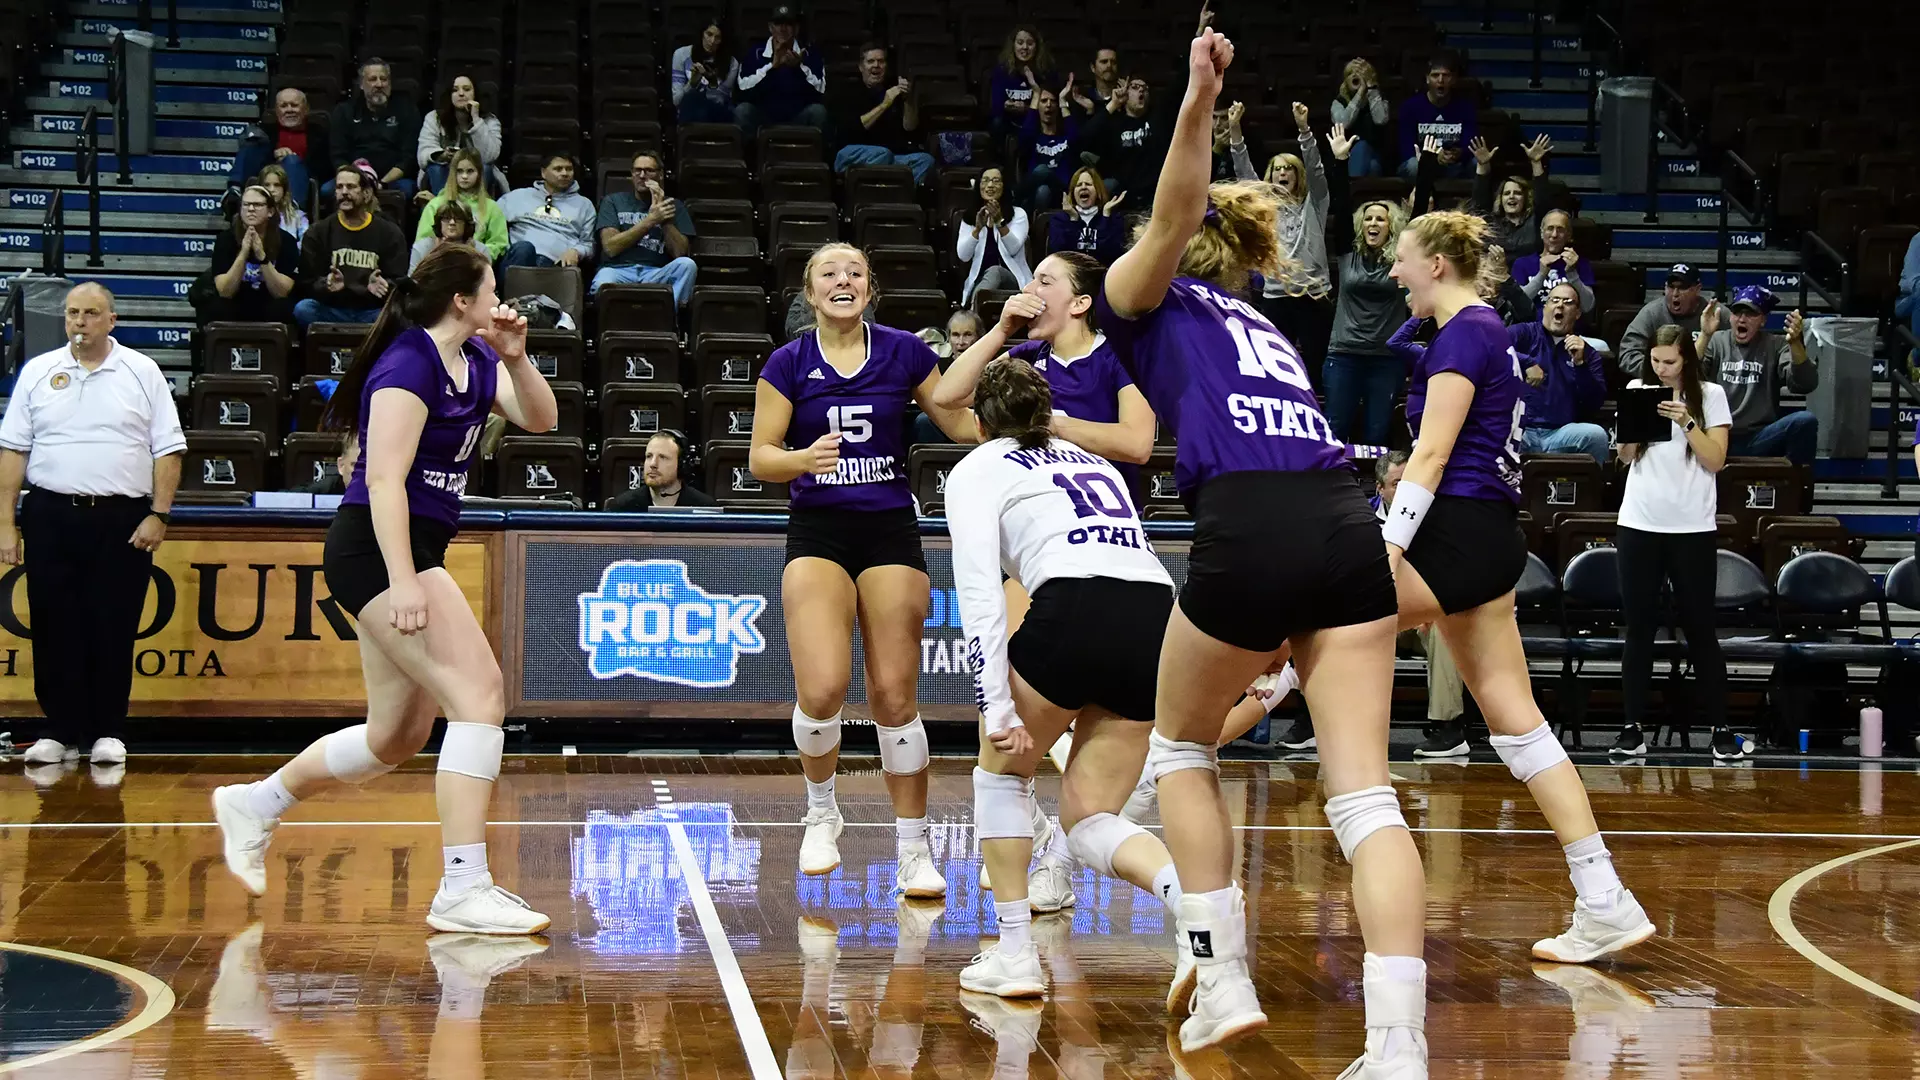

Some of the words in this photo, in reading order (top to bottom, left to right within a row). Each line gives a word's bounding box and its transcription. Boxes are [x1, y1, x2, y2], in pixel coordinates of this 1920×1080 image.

[240, 28, 258, 38] 103
[86, 53, 105, 63] 102
[236, 59, 253, 69] 103
[72, 85, 92, 96] 102
[227, 91, 246, 102] 103
[56, 120, 75, 131] 102
[215, 126, 235, 137] 103
[36, 156, 56, 167] 102
[200, 161, 220, 172] 103
[1667, 163, 1685, 173] 104
[25, 194, 46, 205] 102
[195, 199, 215, 210] 103
[1696, 197, 1714, 208] 104
[9, 235, 30, 246] 102
[1731, 235, 1750, 245] 104
[183, 241, 205, 252] 103
[1767, 276, 1786, 286] 104
[157, 330, 180, 341] 103
[1225, 316, 1312, 392] 16
[1899, 411, 1914, 423] 04
[826, 404, 873, 444] 15
[1053, 472, 1133, 519] 10
[617, 583, 675, 599] BLUE
[588, 601, 757, 645] ROCK
[618, 646, 650, 658] BAR
[670, 646, 714, 658] GRILL
